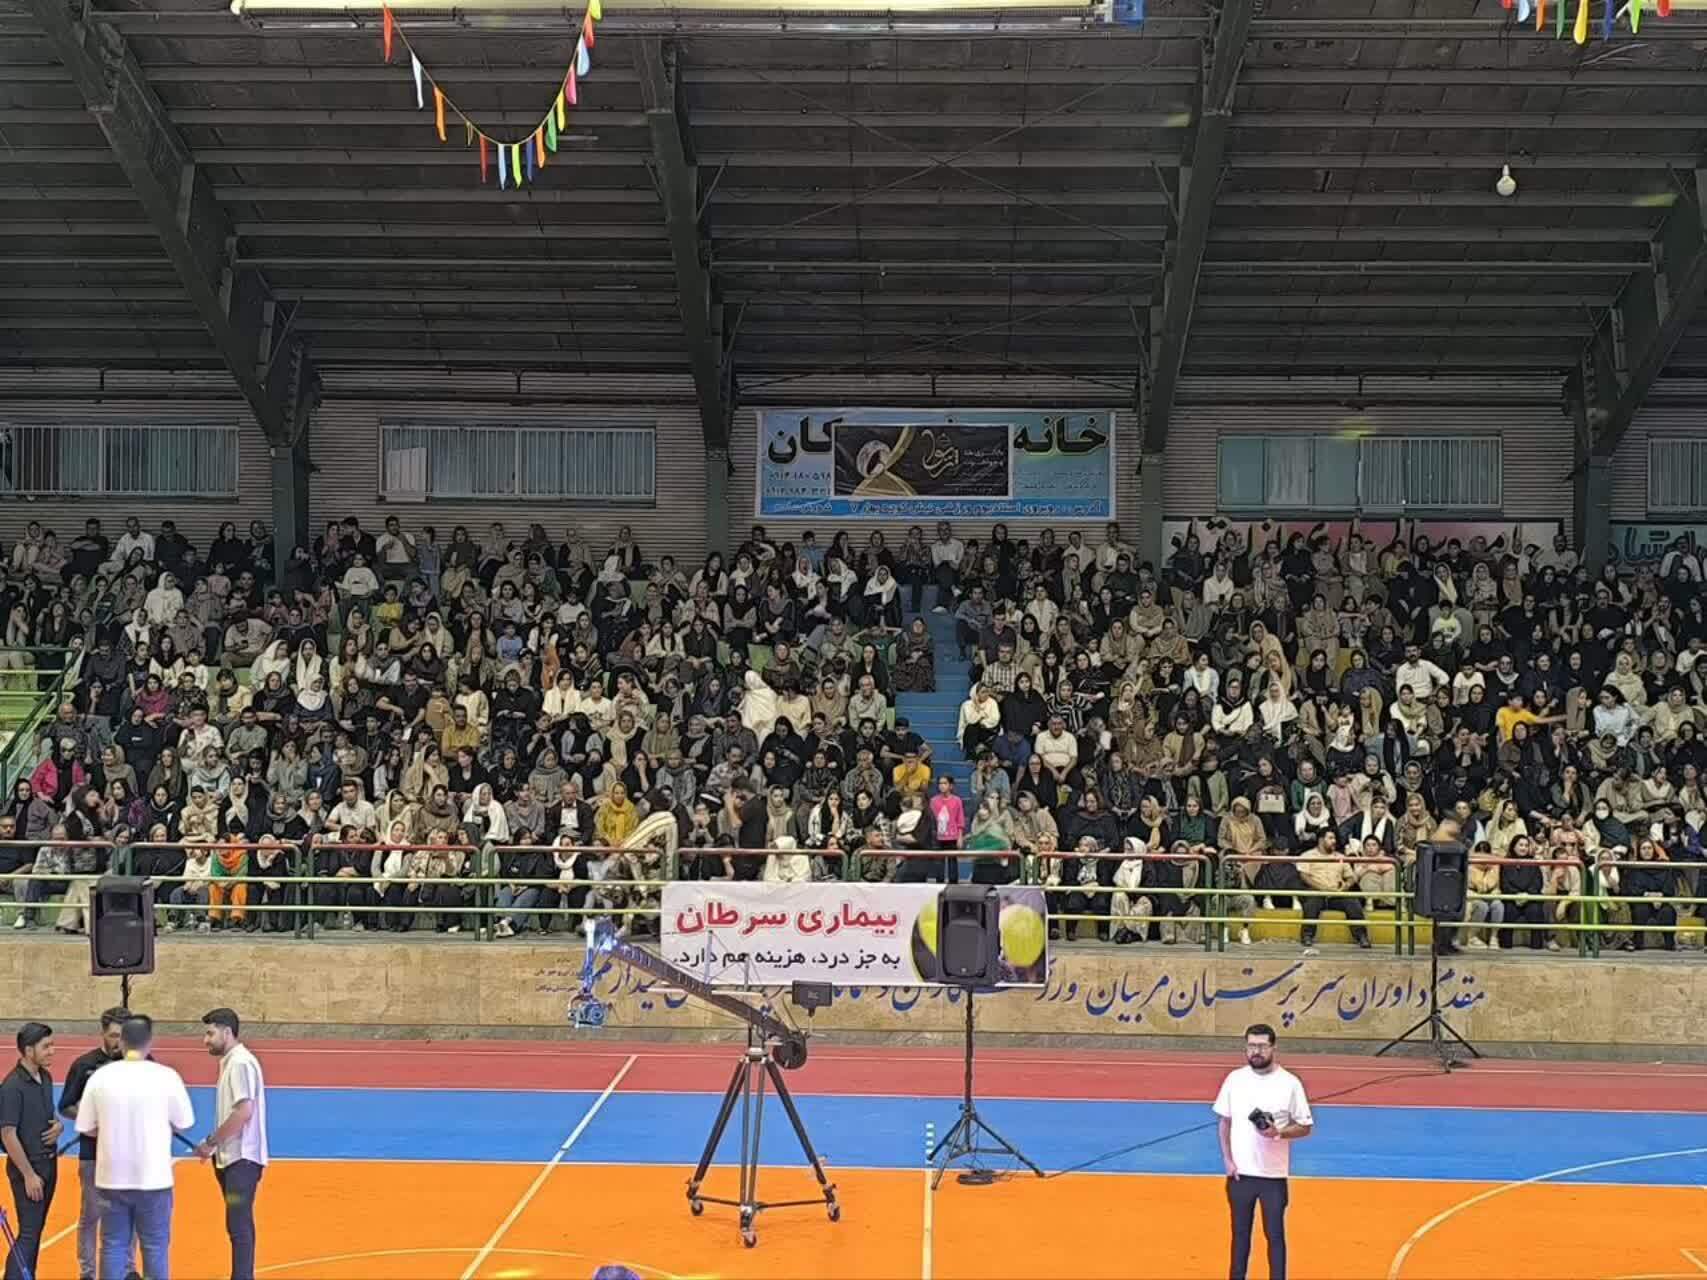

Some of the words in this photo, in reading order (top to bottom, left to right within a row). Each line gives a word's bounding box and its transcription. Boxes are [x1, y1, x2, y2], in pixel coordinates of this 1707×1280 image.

[1014, 417, 1106, 453] خانه
[676, 902, 788, 935] سرطان
[797, 903, 898, 935] بیماری
[722, 951, 749, 969] هم
[754, 950, 806, 969] هزینه
[811, 951, 849, 968] درد،
[854, 949, 877, 969] جز
[881, 954, 901, 970] به
[1085, 971, 1170, 1024] مربیان
[1338, 975, 1428, 1021] داوران
